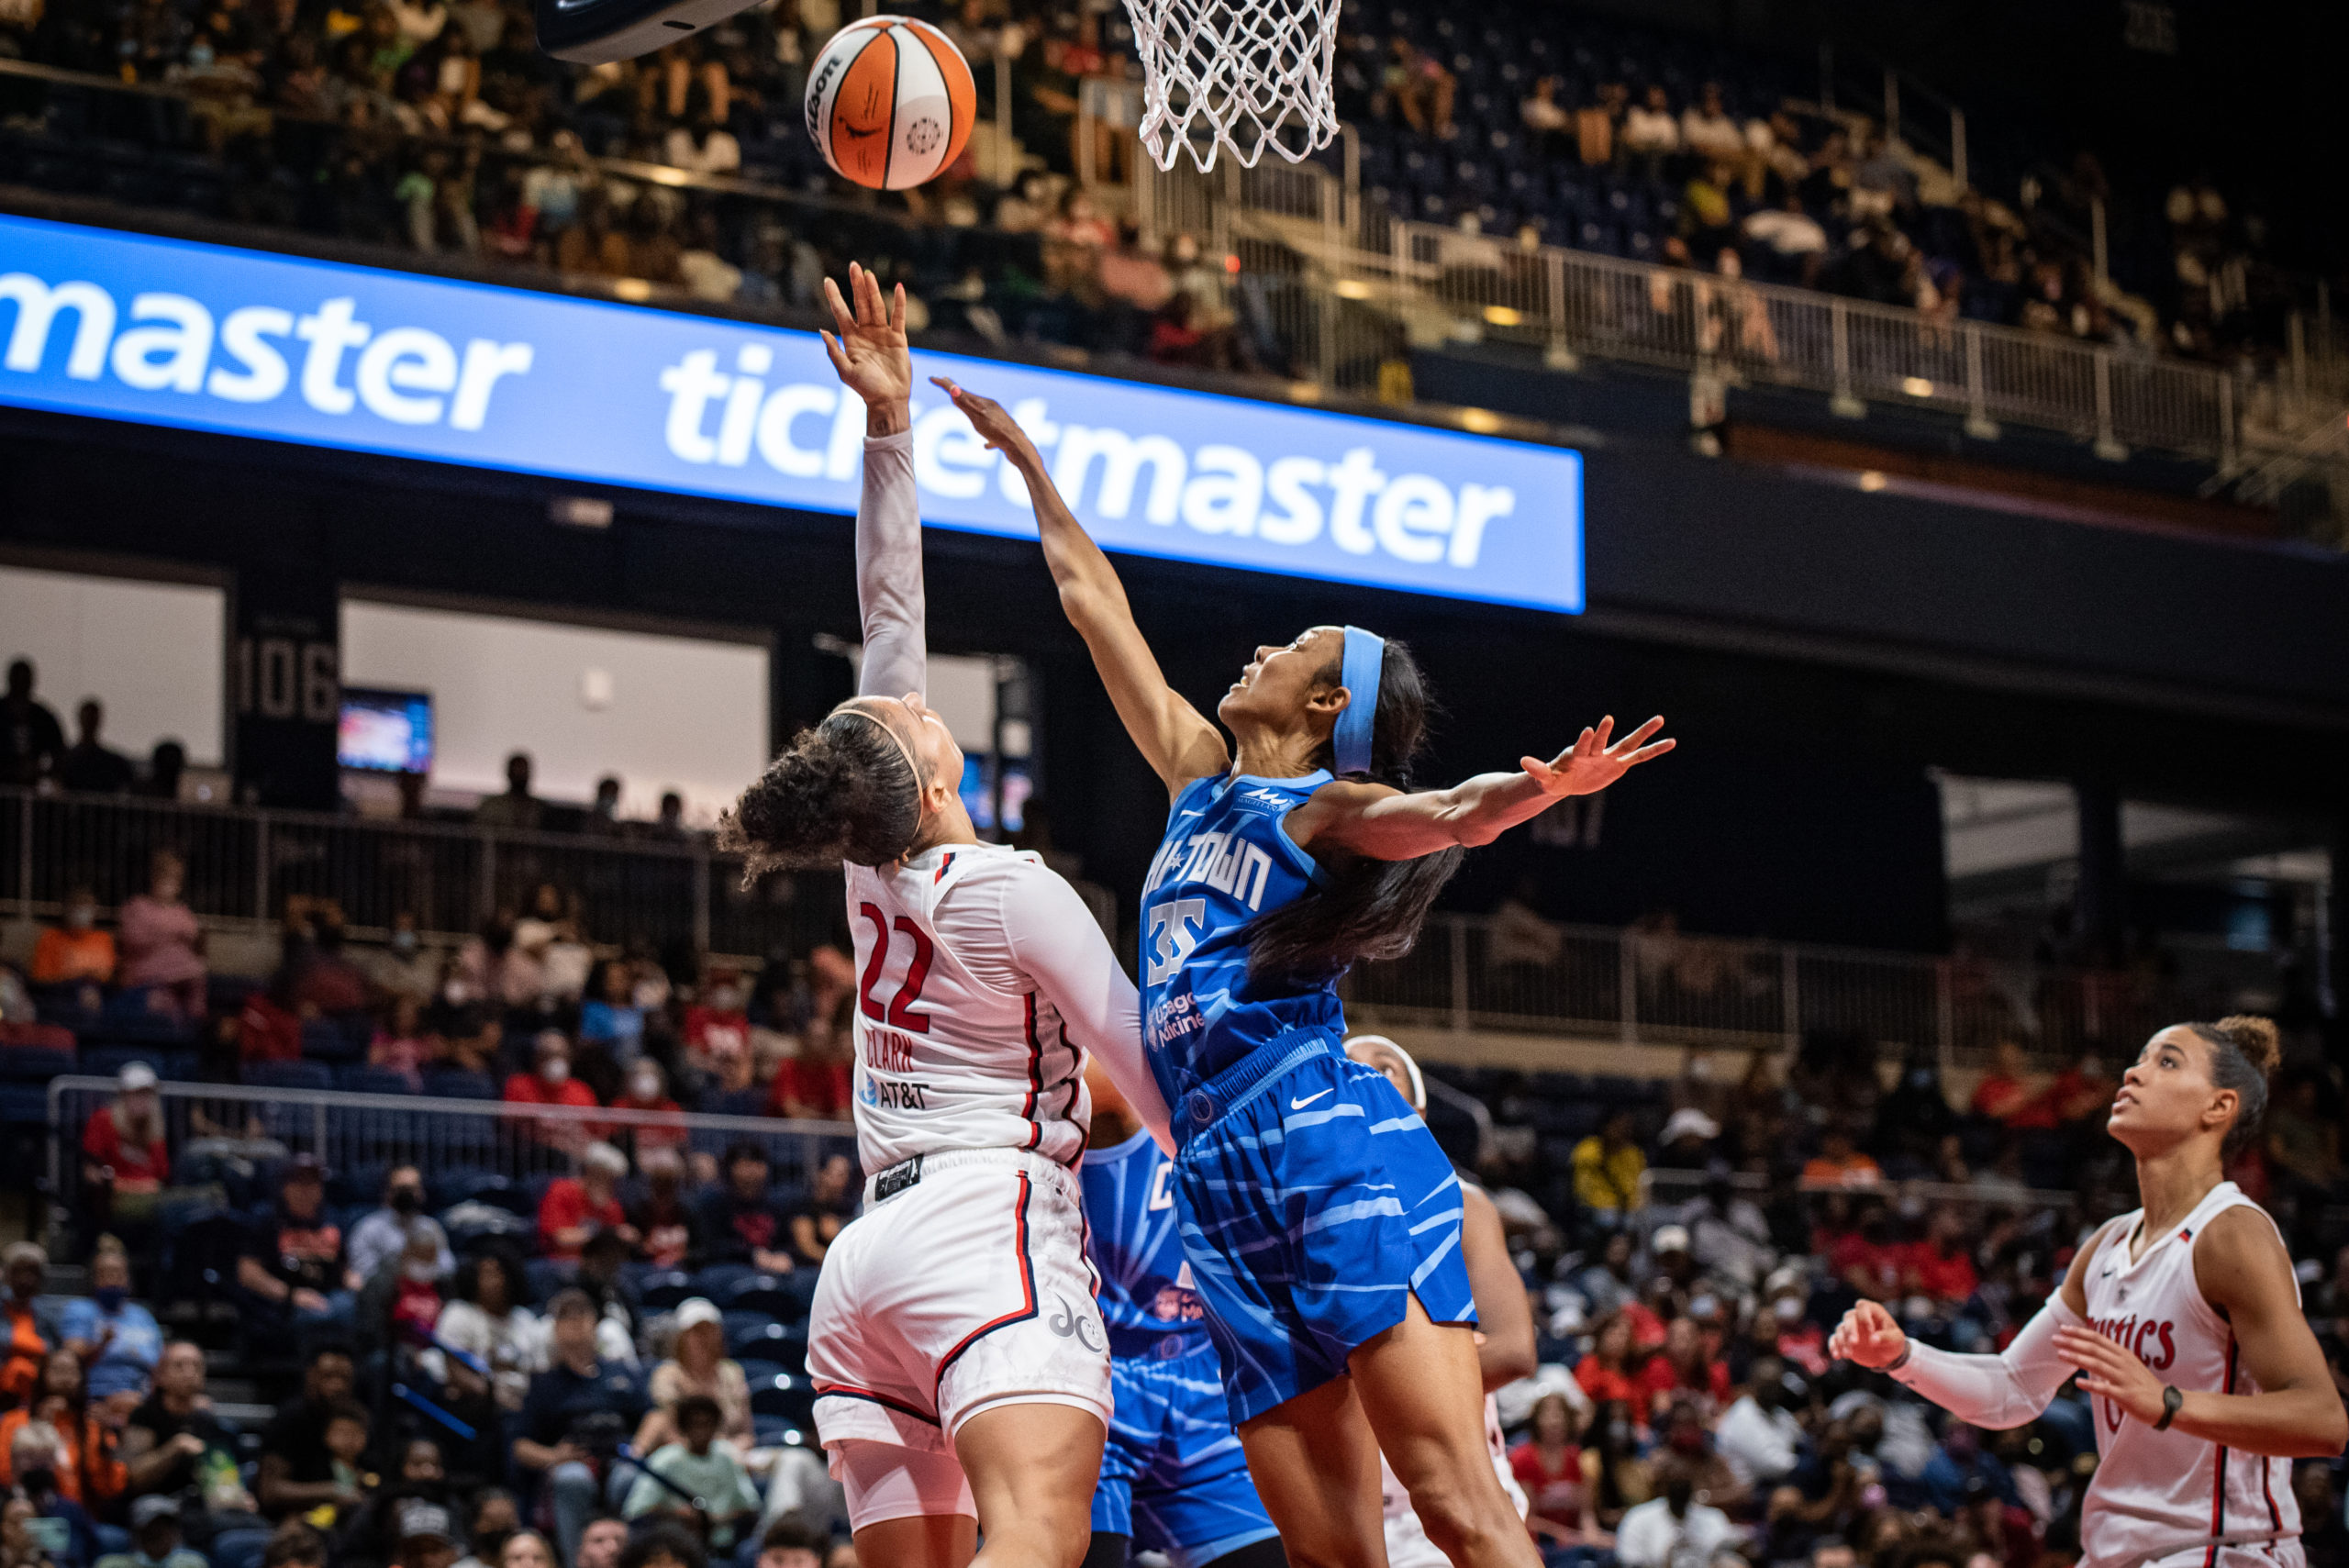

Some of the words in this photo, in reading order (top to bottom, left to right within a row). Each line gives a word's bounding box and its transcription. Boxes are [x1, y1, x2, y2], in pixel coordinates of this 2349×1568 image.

[238, 637, 337, 722] 106
[1237, 796, 1278, 812] MAGELLAN
[860, 902, 933, 1034] 22
[1147, 898, 1206, 987] 35
[864, 1029, 914, 1073] CLARK
[880, 1081, 930, 1109] AT&T
